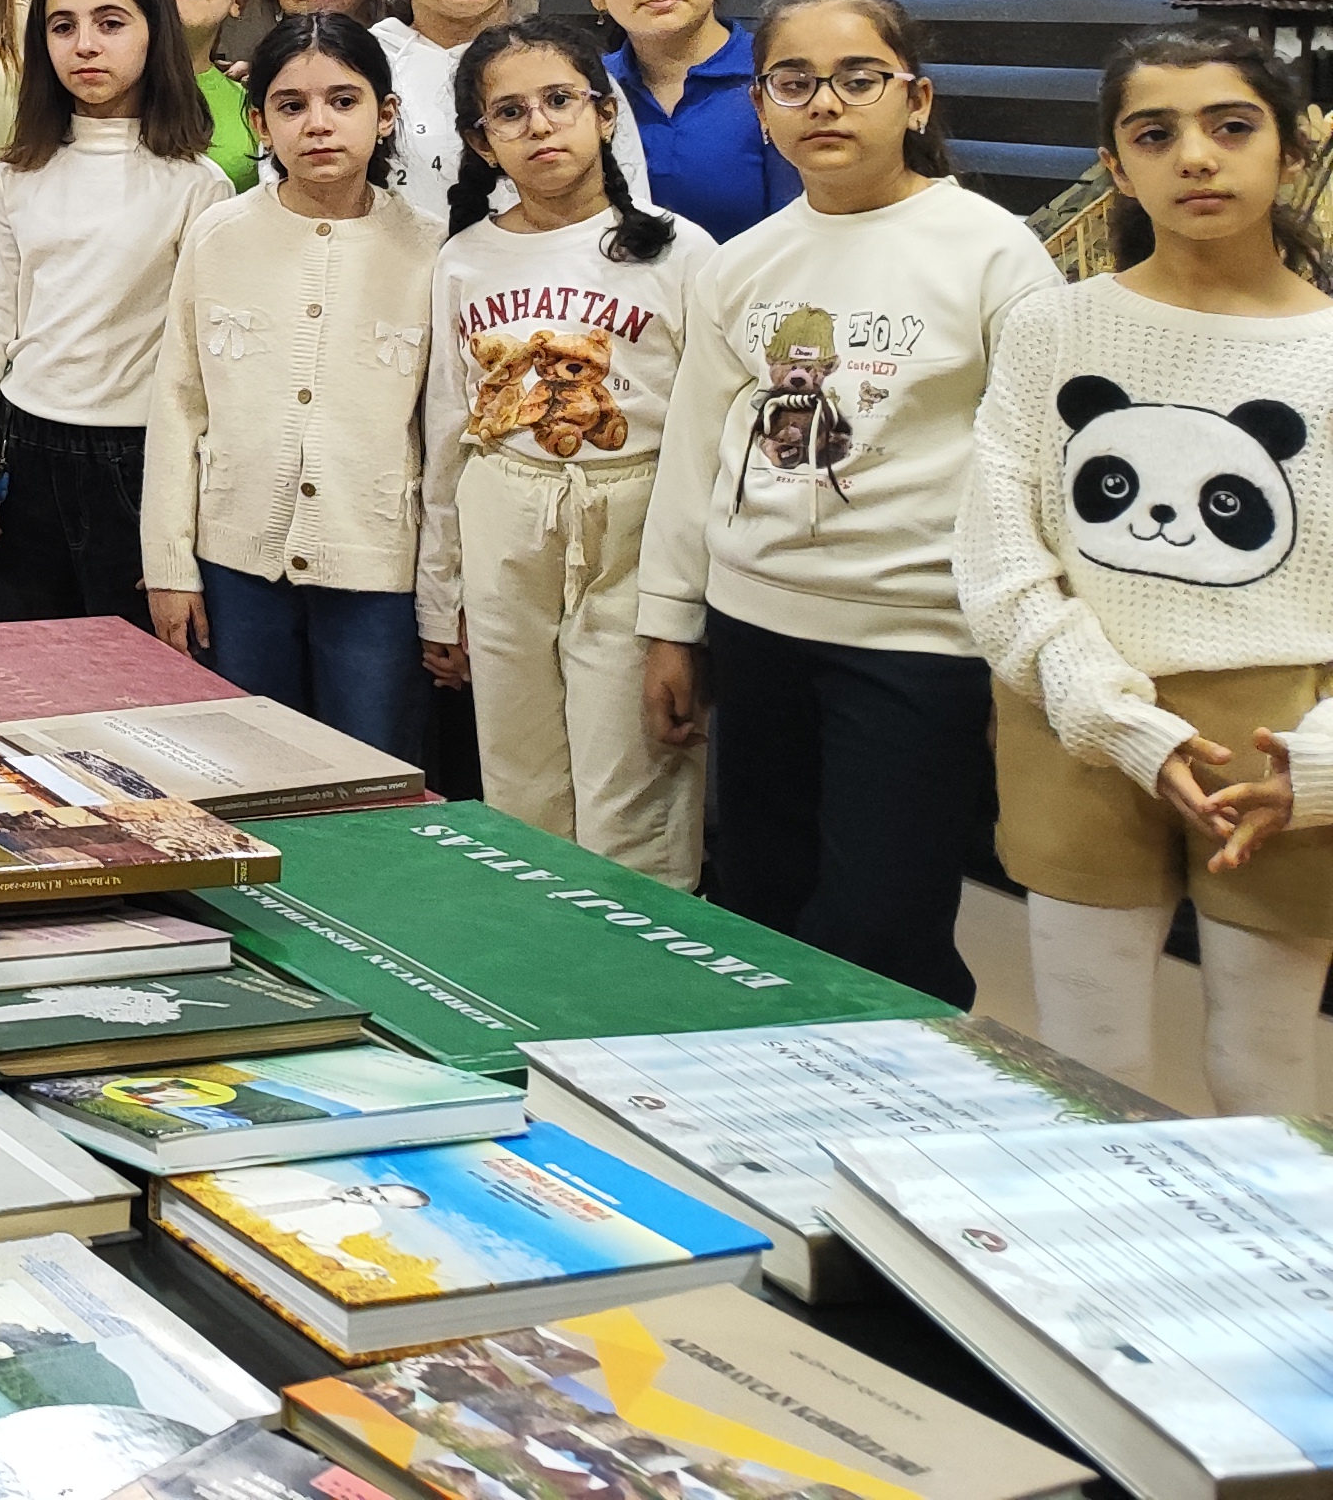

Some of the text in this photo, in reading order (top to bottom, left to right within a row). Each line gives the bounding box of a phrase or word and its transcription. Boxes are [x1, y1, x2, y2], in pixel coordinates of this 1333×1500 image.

[458, 286, 655, 347] MANHATTAN
[849, 311, 925, 357] TOY
[612, 378, 631, 392] 90
[225, 880, 372, 955] RESPUBLİKAS
[399, 816, 795, 993] EKOLOJİ ATLAS
[356, 951, 519, 1033] AZƏRBAYCAN
[754, 1039, 871, 1097] KONFRANS
[1094, 1141, 1243, 1236] KONFRANS
[657, 1334, 802, 1408] AZƏRBAYCAN
